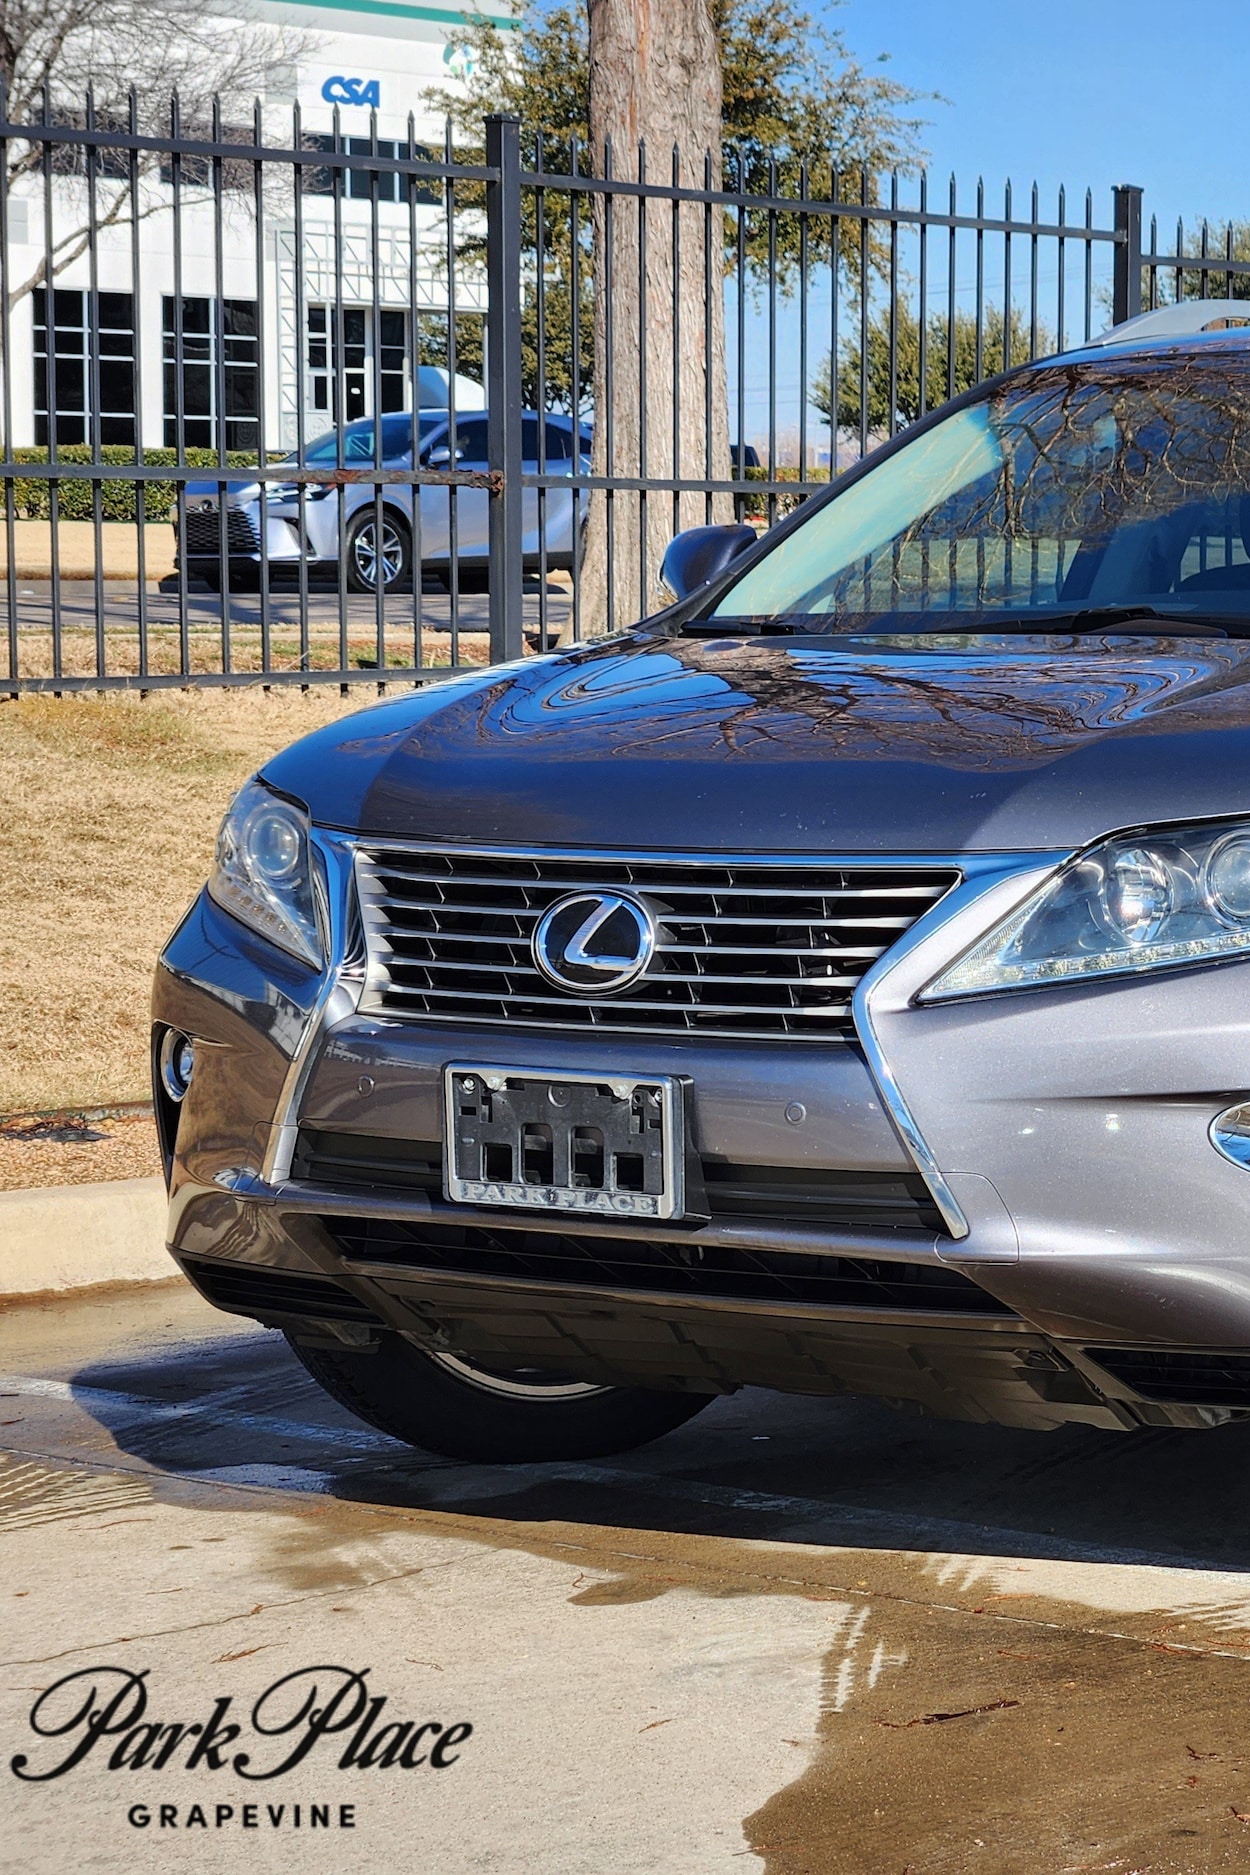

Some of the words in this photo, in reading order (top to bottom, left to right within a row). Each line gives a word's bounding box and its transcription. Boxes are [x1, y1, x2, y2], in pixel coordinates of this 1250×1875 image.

[321, 75, 380, 108] CSA
[465, 1183, 547, 1205] PARK
[555, 1189, 654, 1214] PLACE
